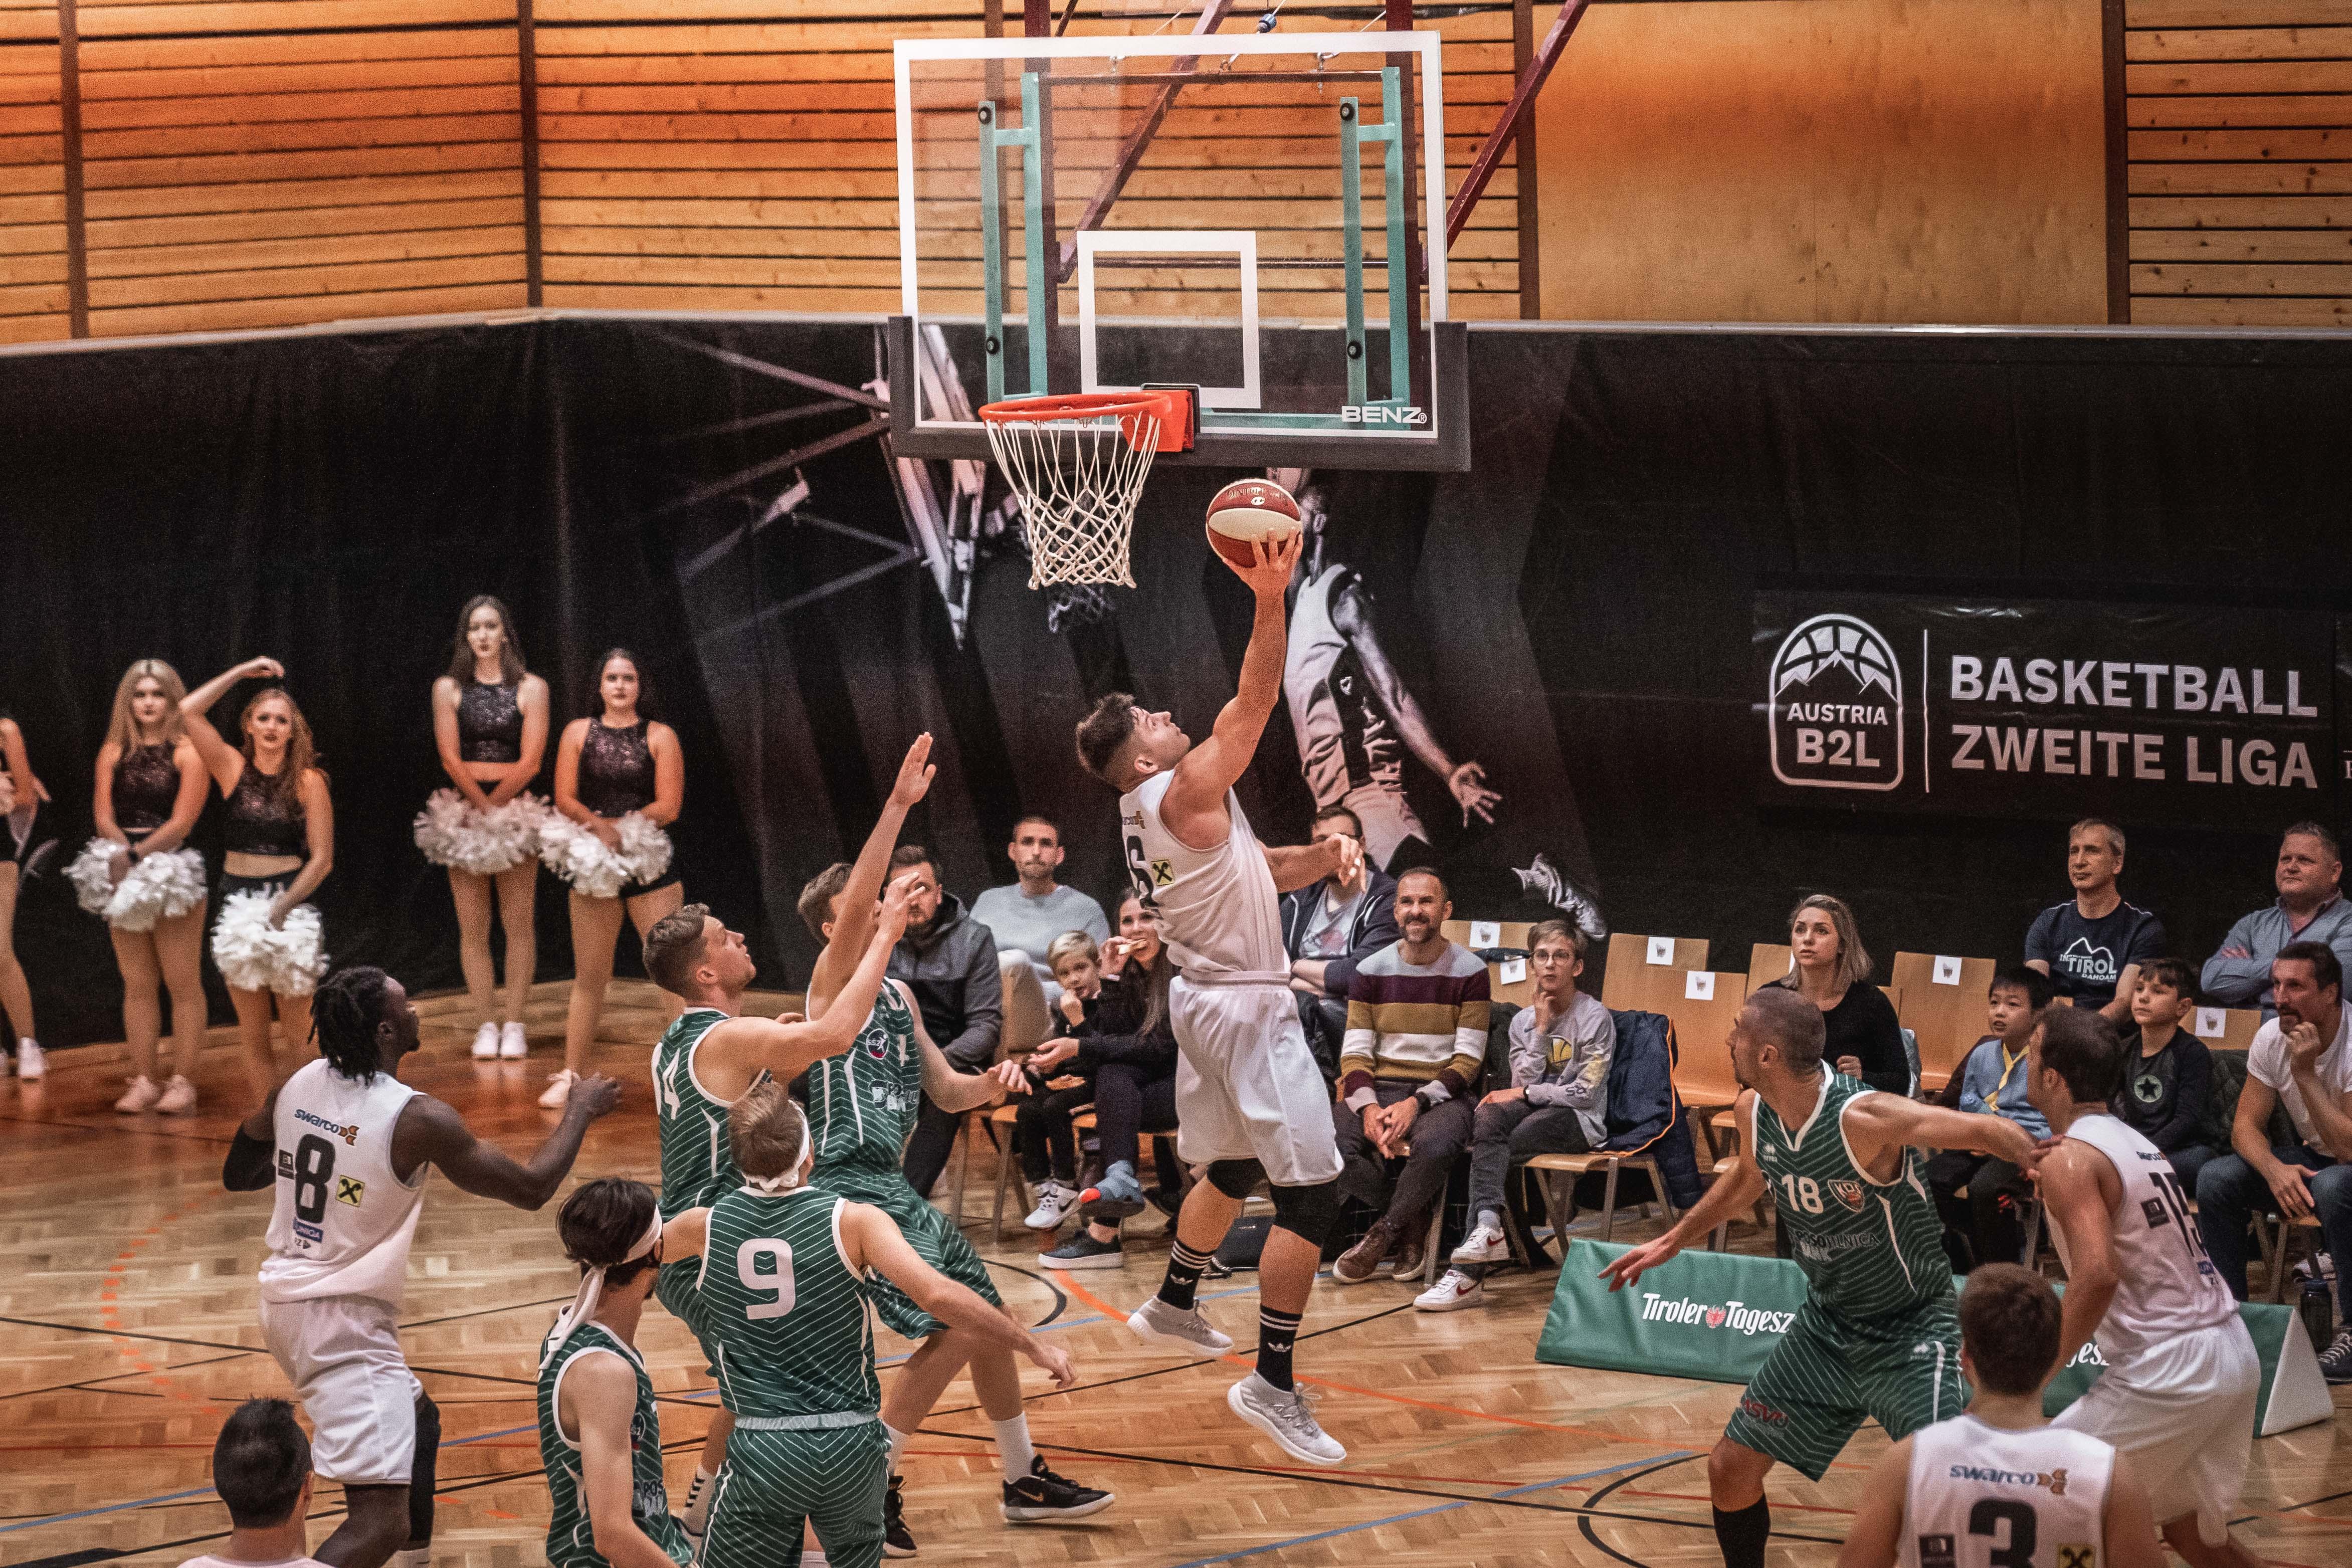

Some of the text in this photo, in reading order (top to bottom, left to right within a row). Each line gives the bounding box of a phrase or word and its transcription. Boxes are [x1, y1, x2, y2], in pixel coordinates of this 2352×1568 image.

[1950, 655, 2317, 717] BASKETBALL
[1787, 702, 1888, 726] AUSTRIA
[1797, 728, 1880, 768] B2L
[1951, 725, 2166, 780] ZWEITE
[2187, 736, 2317, 789] LIGA
[2068, 957, 2117, 974] TIROL
[294, 1109, 339, 1133] swarco
[295, 1133, 336, 1224] 8
[1782, 1174, 1824, 1214] 18
[737, 1238, 797, 1320] 9
[1642, 1292, 1708, 1325] Tiroler
[1968, 1495, 2038, 1568] 3
